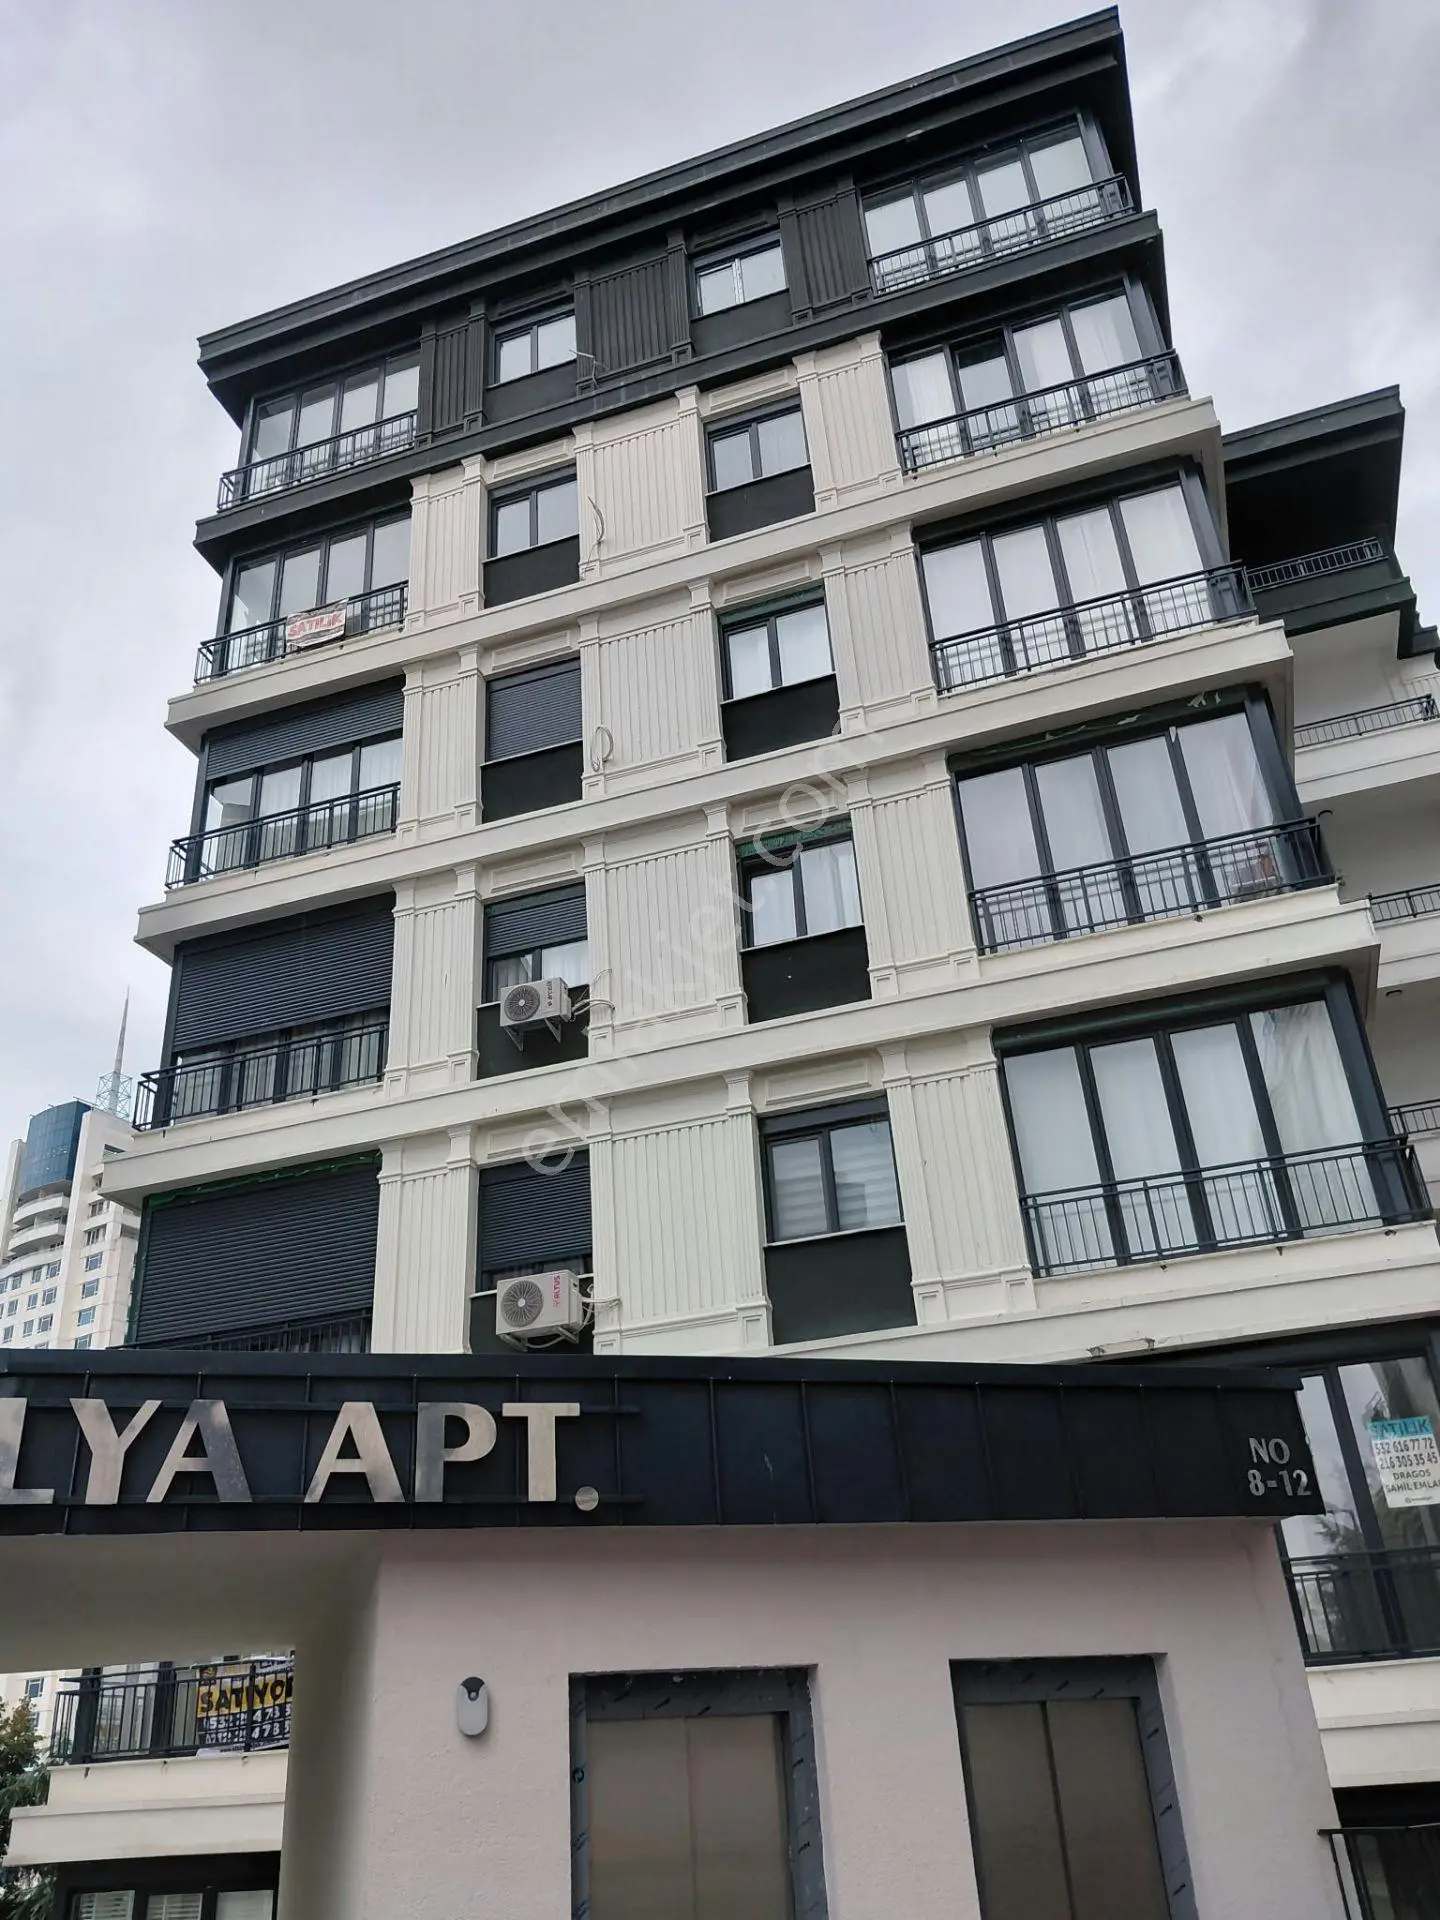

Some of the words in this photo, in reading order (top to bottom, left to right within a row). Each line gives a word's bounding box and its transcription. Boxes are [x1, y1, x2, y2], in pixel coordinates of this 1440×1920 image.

[0, 1398, 252, 1505] LYA
[304, 1402, 599, 1511] APT.
[1249, 1437, 1291, 1465] NO
[1247, 1469, 1312, 1497] 8-12
[1393, 1469, 1431, 1480] DRAGOS
